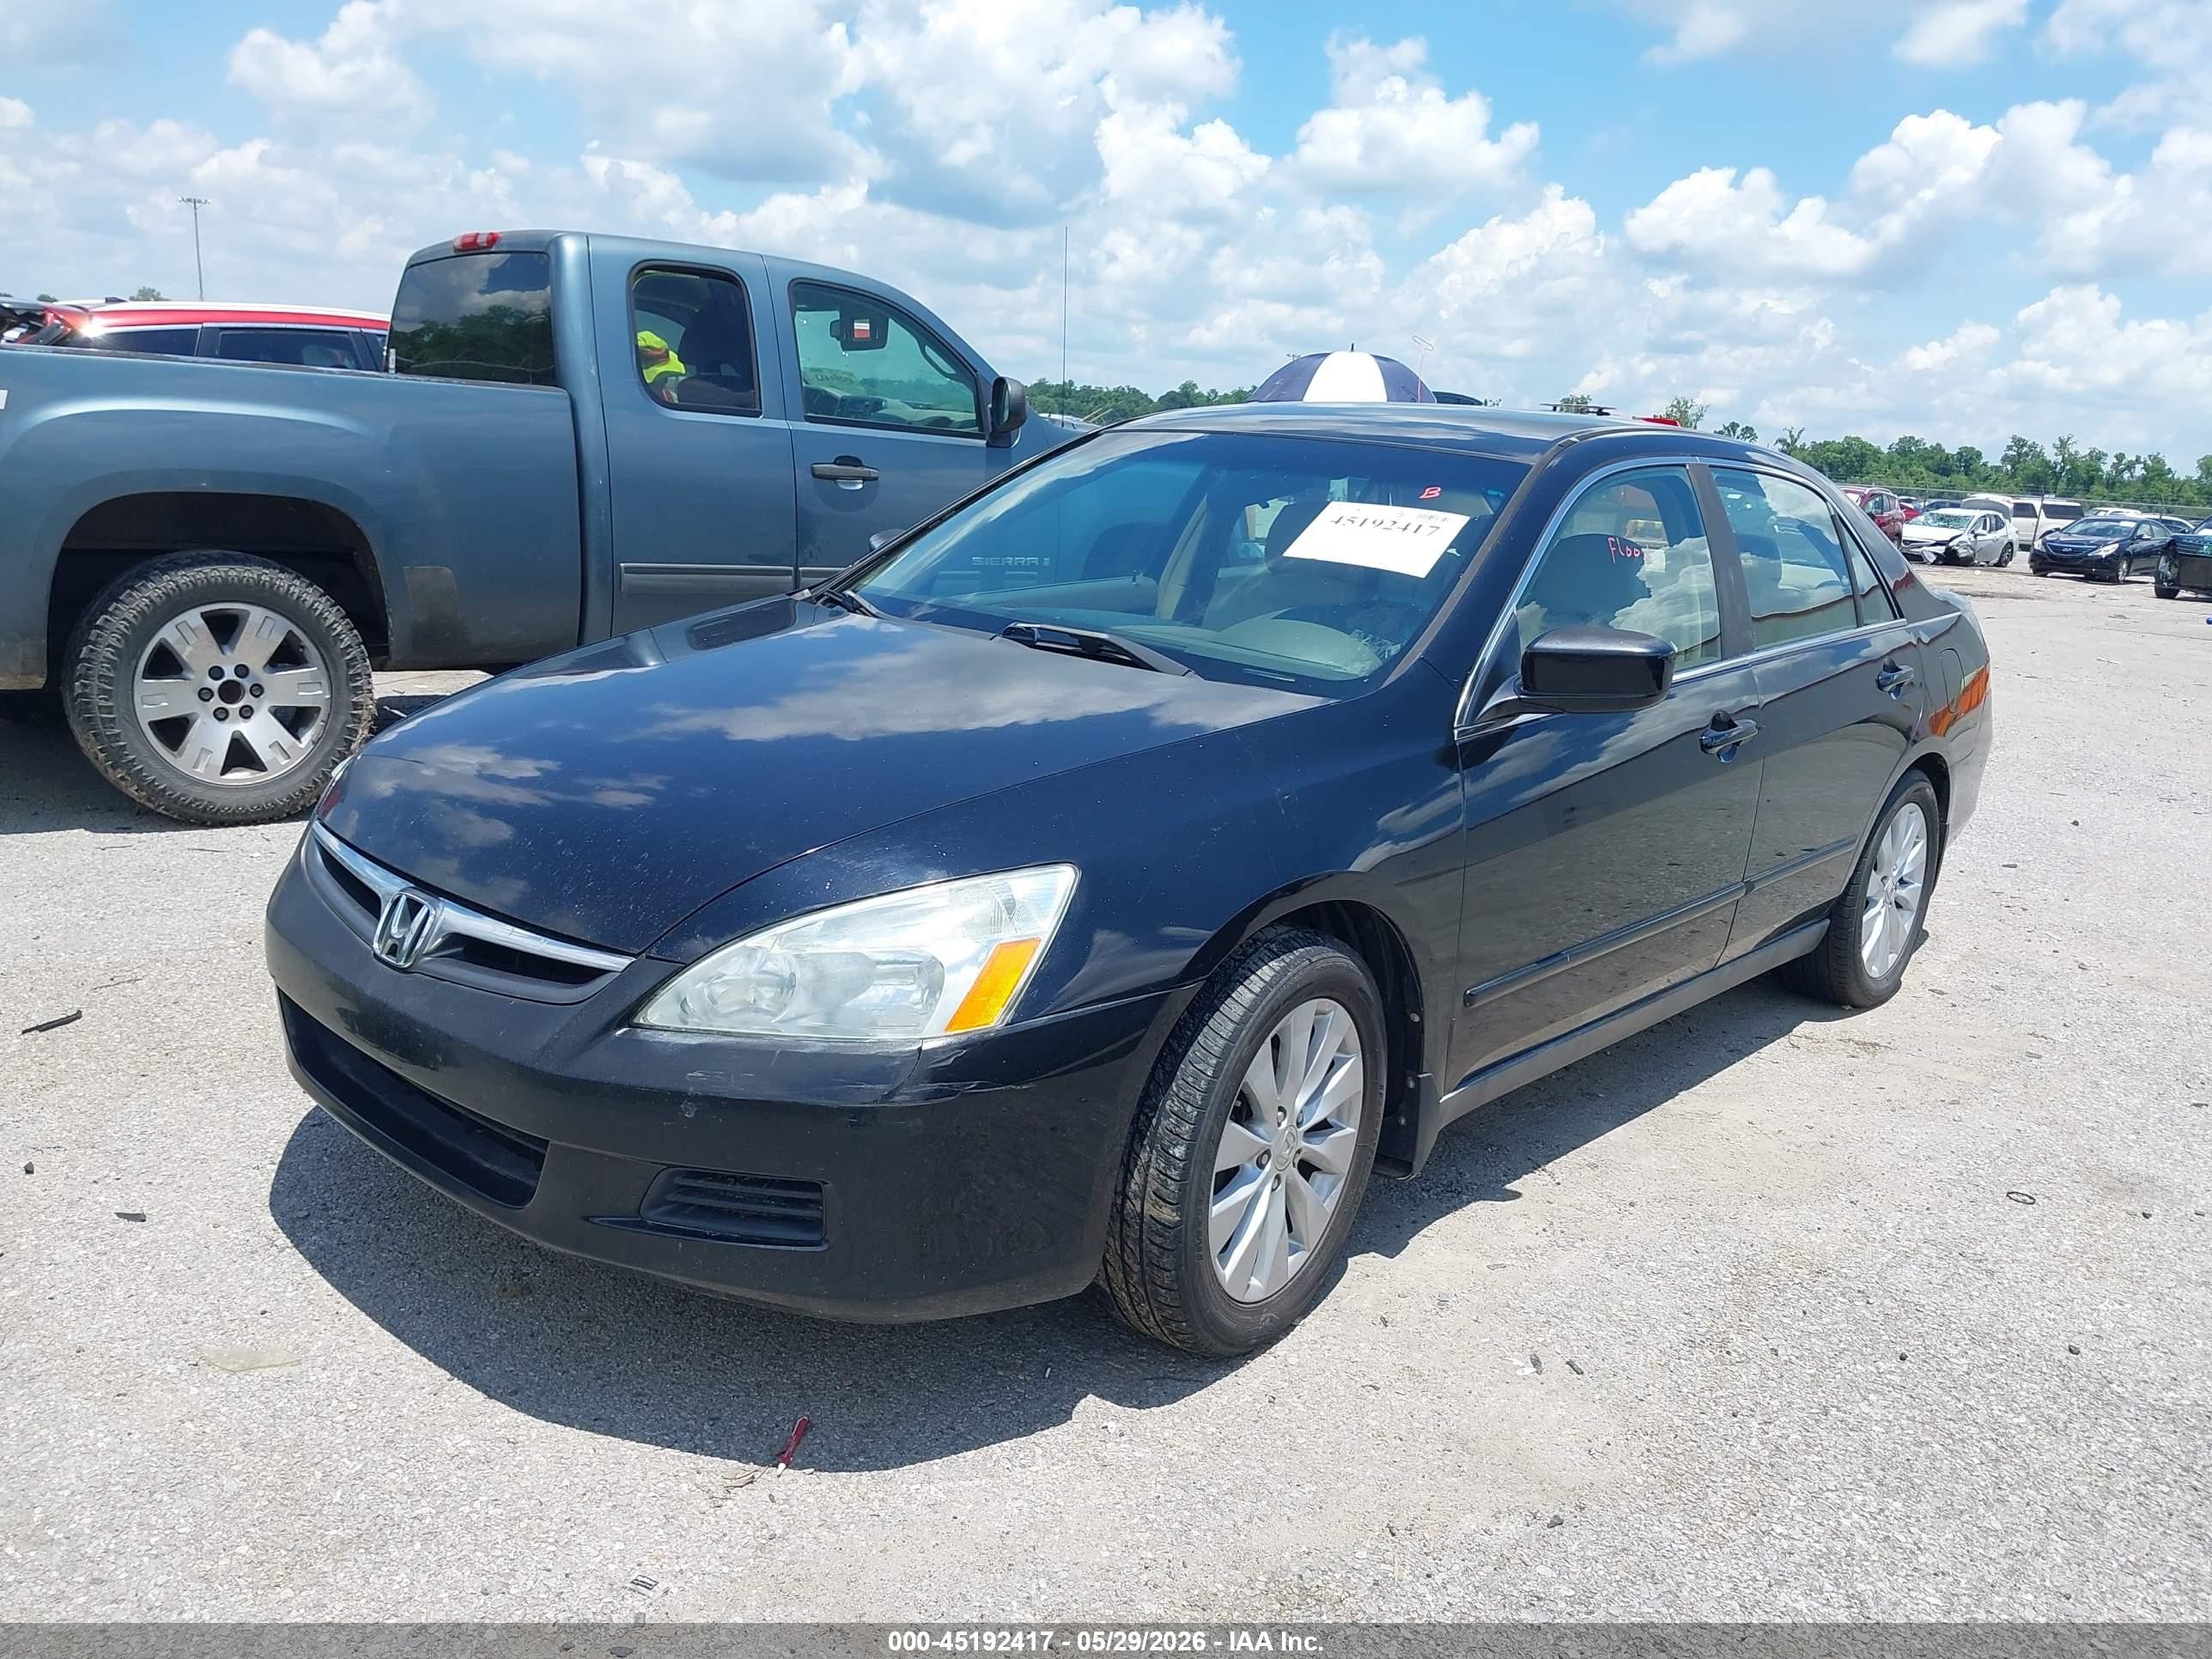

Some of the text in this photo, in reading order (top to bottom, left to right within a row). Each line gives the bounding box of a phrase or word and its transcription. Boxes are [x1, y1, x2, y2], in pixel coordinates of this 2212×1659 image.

[1419, 486, 1442, 500] B
[1329, 515, 1441, 537] 45192417
[971, 556, 1039, 566] SIERRA
